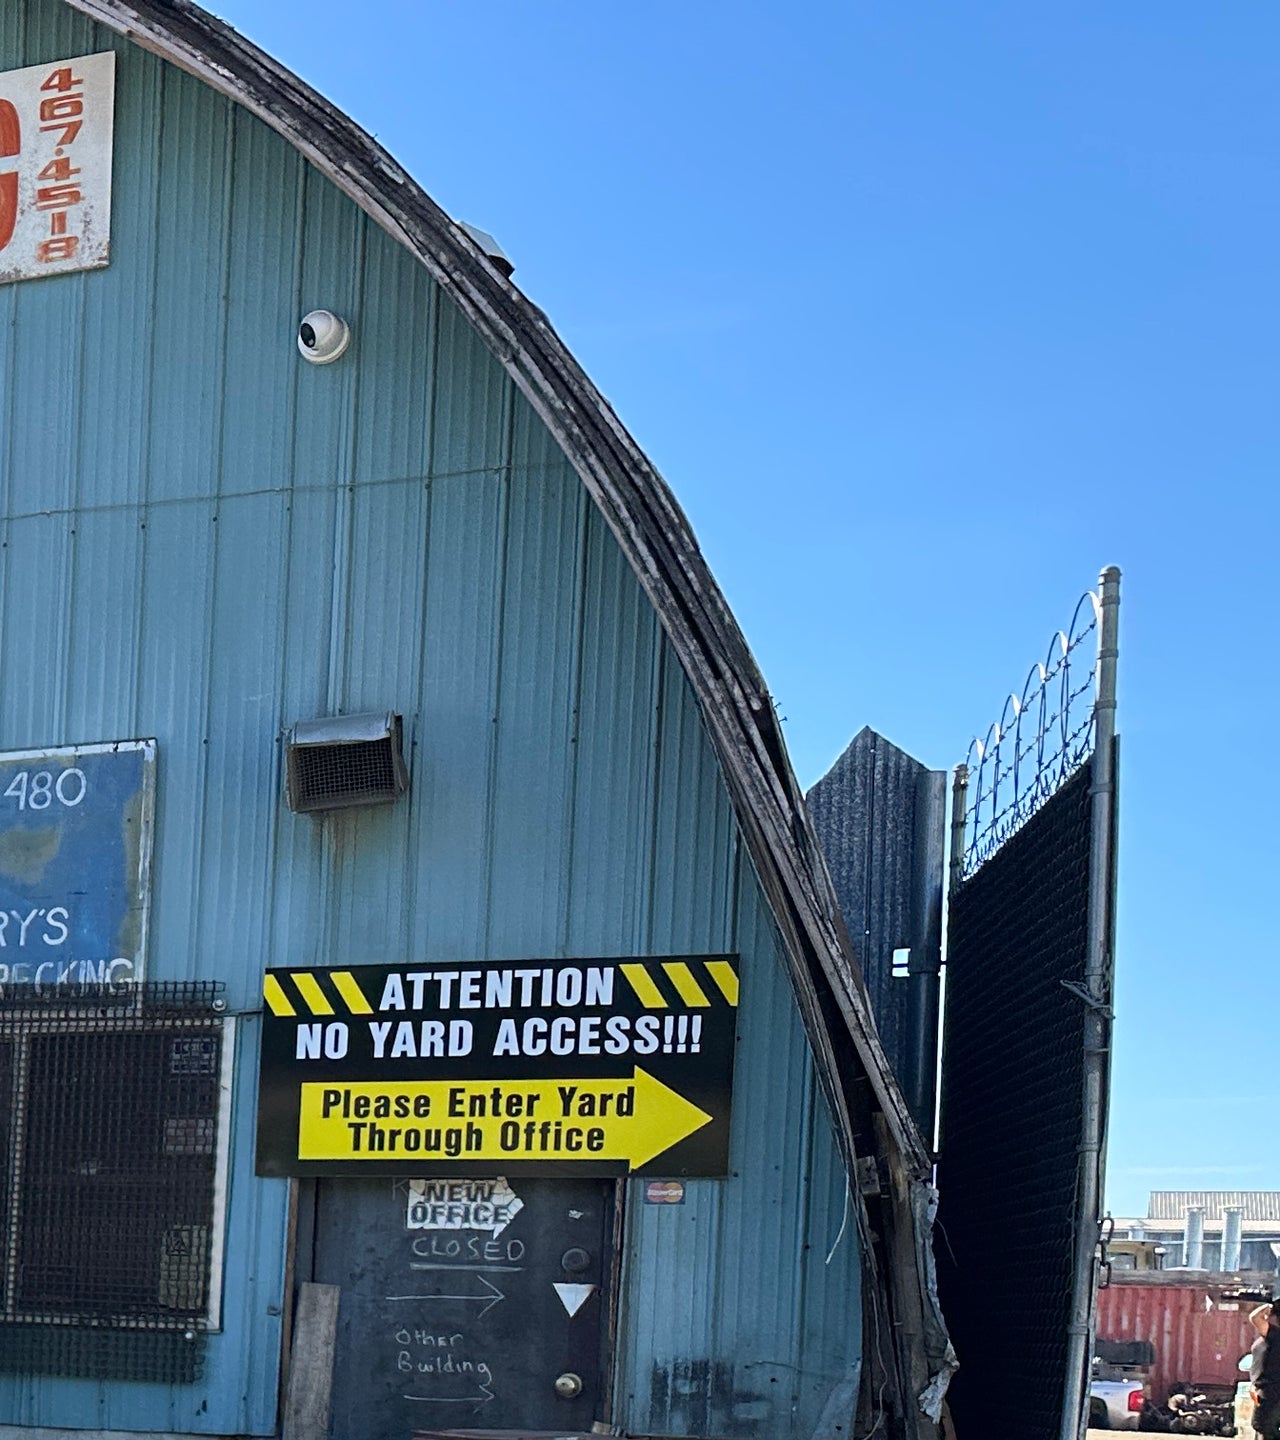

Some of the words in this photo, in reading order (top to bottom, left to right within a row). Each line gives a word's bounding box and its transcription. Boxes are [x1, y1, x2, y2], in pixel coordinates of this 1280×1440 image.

[379, 967, 615, 1011] ATTENTION
[296, 1022, 349, 1060] NO
[368, 1019, 474, 1058] YARD
[494, 1015, 703, 1057] ACCESS!!!
[322, 1089, 431, 1120] Please
[448, 1087, 540, 1118] Enter
[556, 1086, 636, 1118] Yard
[347, 1121, 483, 1157] Through
[499, 1121, 605, 1152] Office
[426, 1181, 491, 1202] NEW
[410, 1201, 510, 1225] OFFICE
[412, 1236, 525, 1261] CLOSED
[398, 1351, 492, 1387] Building
